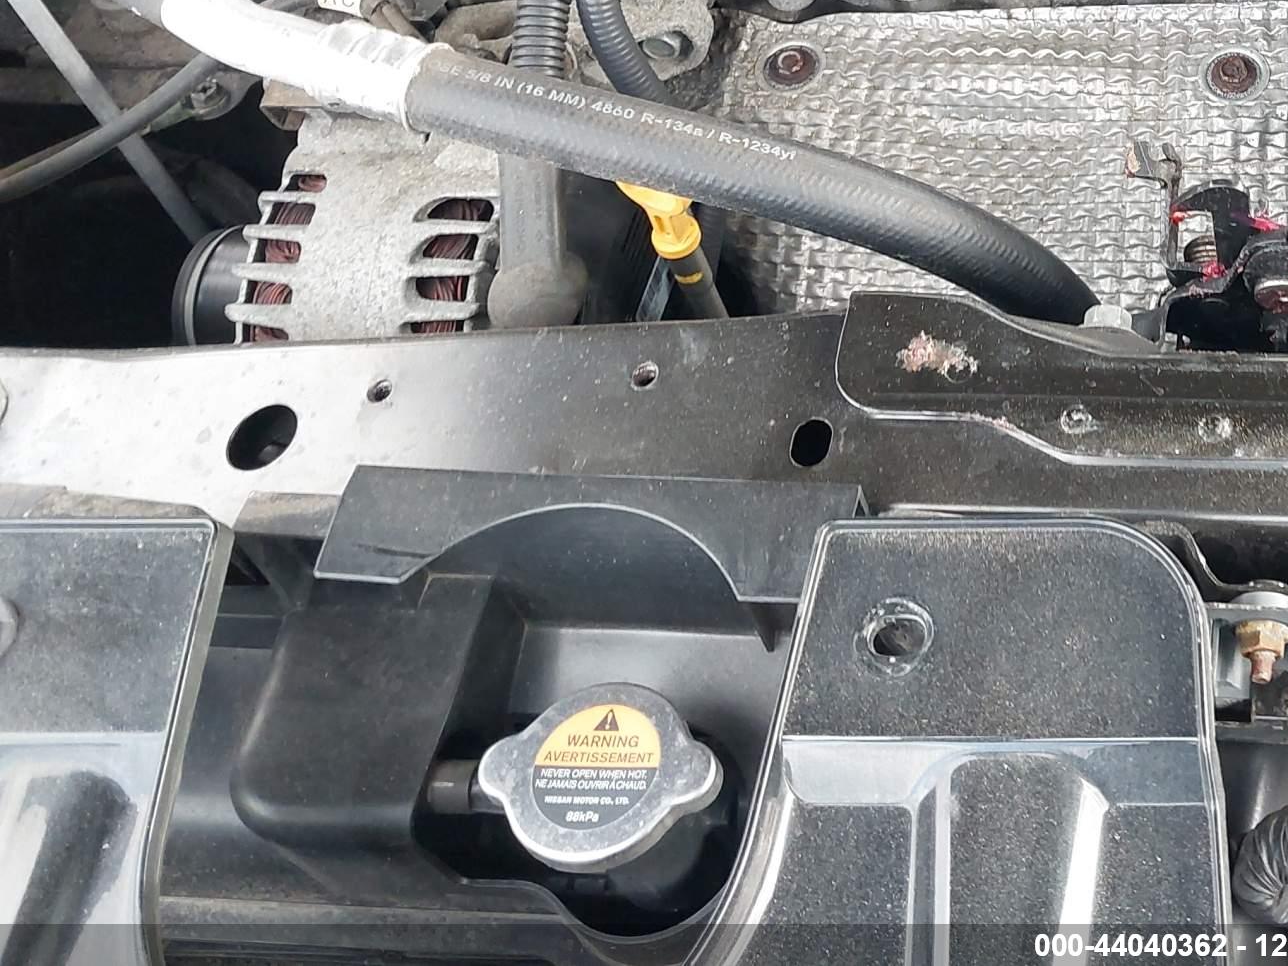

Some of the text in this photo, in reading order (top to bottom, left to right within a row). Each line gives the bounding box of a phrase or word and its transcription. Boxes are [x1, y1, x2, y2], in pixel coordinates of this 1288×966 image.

[465, 68, 492, 84] 5/8
[494, 76, 516, 90] IN
[517, 82, 544, 97] (16
[548, 89, 586, 110] MM)
[591, 101, 636, 120] 4860
[640, 112, 704, 138] R-134a
[718, 131, 798, 161] R-1234yf
[567, 735, 640, 748] WARNING
[544, 751, 654, 763] AVERTISSEMENT
[540, 768, 648, 780] NEVER OPEN WHEN HOT.
[536, 779, 548, 788] NE
[548, 780, 578, 790] JAMAIS
[578, 780, 609, 790] OUVRIR
[616, 781, 647, 790] CHAUD.
[544, 796, 572, 804] NISSAN
[573, 796, 600, 804] MOTOR
[566, 811, 600, 822] 88kPa
